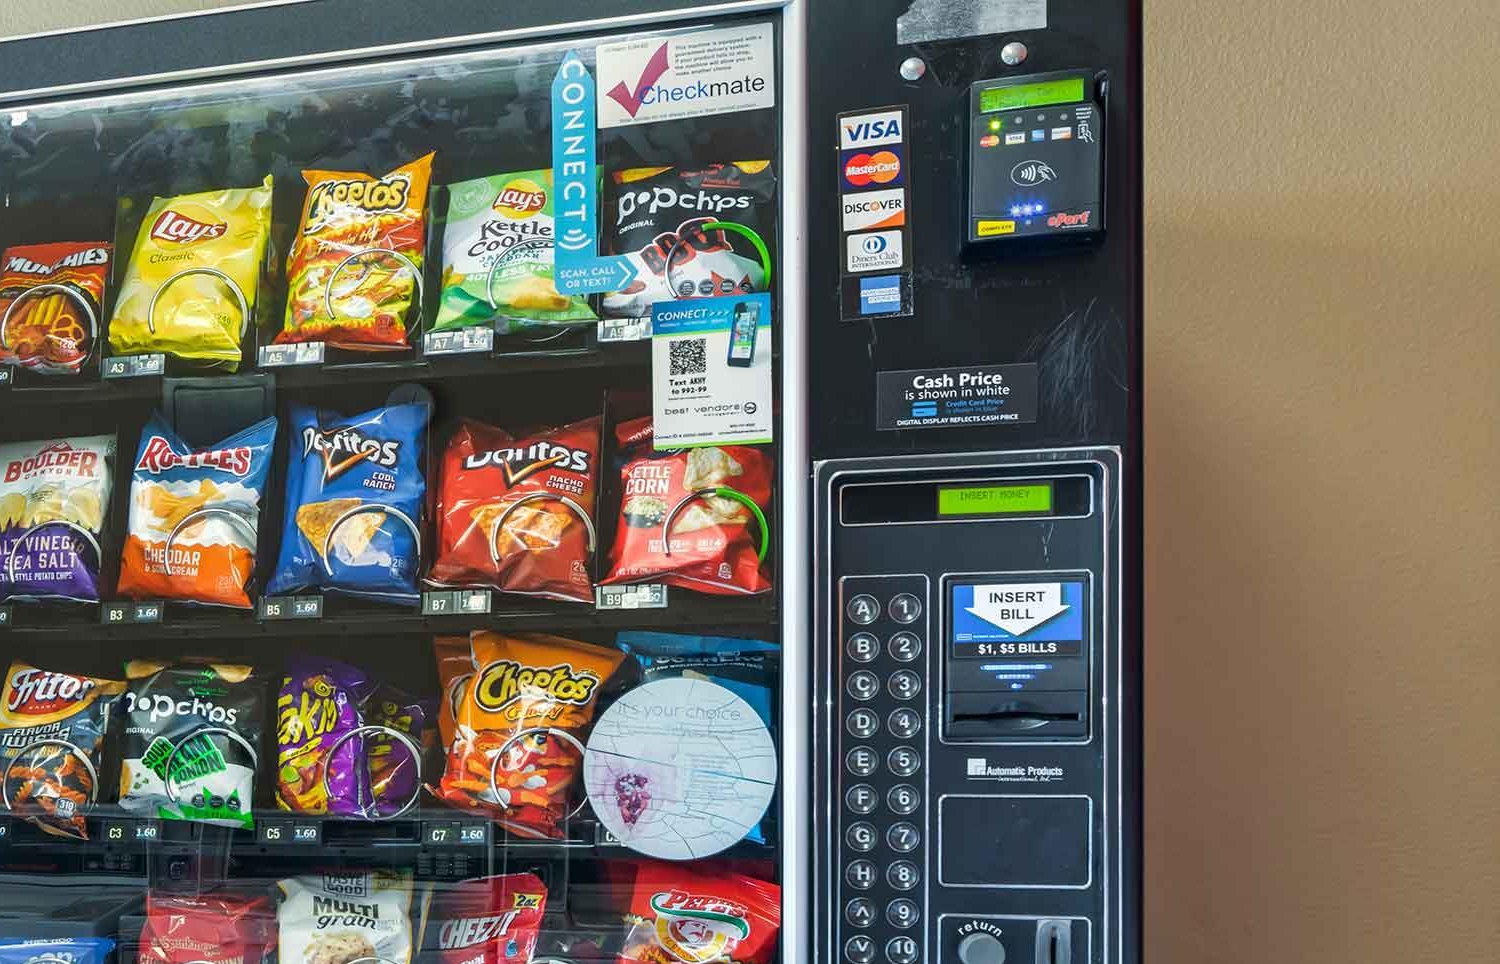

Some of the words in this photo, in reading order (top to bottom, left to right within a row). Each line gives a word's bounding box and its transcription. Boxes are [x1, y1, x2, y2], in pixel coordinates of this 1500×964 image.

[639, 76, 764, 104] Checkmate
[845, 120, 900, 141] VISA
[560, 57, 588, 222] CONNECT
[846, 160, 900, 177] MasterCard
[844, 199, 902, 214] DISCOVER
[479, 220, 552, 241] Kettle
[619, 219, 655, 234] ORIGINAL
[150, 252, 194, 264] Classic
[852, 255, 876, 264] Diners
[878, 252, 898, 261] Club
[592, 266, 615, 275] CALL
[565, 280, 580, 289] OR
[657, 309, 708, 321] CONNECT
[913, 374, 953, 389] Cash
[959, 372, 1002, 386] Price
[905, 390, 914, 400] is
[918, 388, 957, 399] shown
[962, 387, 972, 396] in
[976, 385, 1010, 396] white
[4, 451, 98, 483] BOULDER
[24, 467, 71, 480] CANYON
[363, 479, 396, 490] RANCH
[373, 472, 396, 483] COOL
[550, 475, 583, 487] NACHO
[546, 481, 584, 494] CHEESE
[626, 478, 670, 494] CORN
[989, 591, 1046, 603] INSERT
[110, 609, 123, 621] B3
[138, 608, 158, 618] 1.60
[267, 604, 280, 616] B5
[296, 602, 317, 614] 1.60
[857, 602, 869, 614] A
[901, 601, 908, 614] 1
[1000, 609, 1035, 620] BILL
[857, 640, 869, 653] B
[899, 639, 910, 653] 2
[1000, 643, 1015, 653] $5
[1018, 642, 1057, 653] BILLS
[9, 668, 94, 712] Fritos
[477, 663, 594, 708] Cheetos
[644, 706, 680, 719] your
[685, 704, 741, 721] choice
[13, 722, 61, 736] FLAVOR
[987, 765, 1026, 777] Automatic
[1027, 765, 1063, 777] Products
[433, 830, 446, 841] C7
[461, 829, 483, 839] 1.60
[312, 896, 380, 918] MULTI
[317, 914, 377, 931] grain
[957, 918, 1004, 938] return
[895, 940, 914, 955] 10
